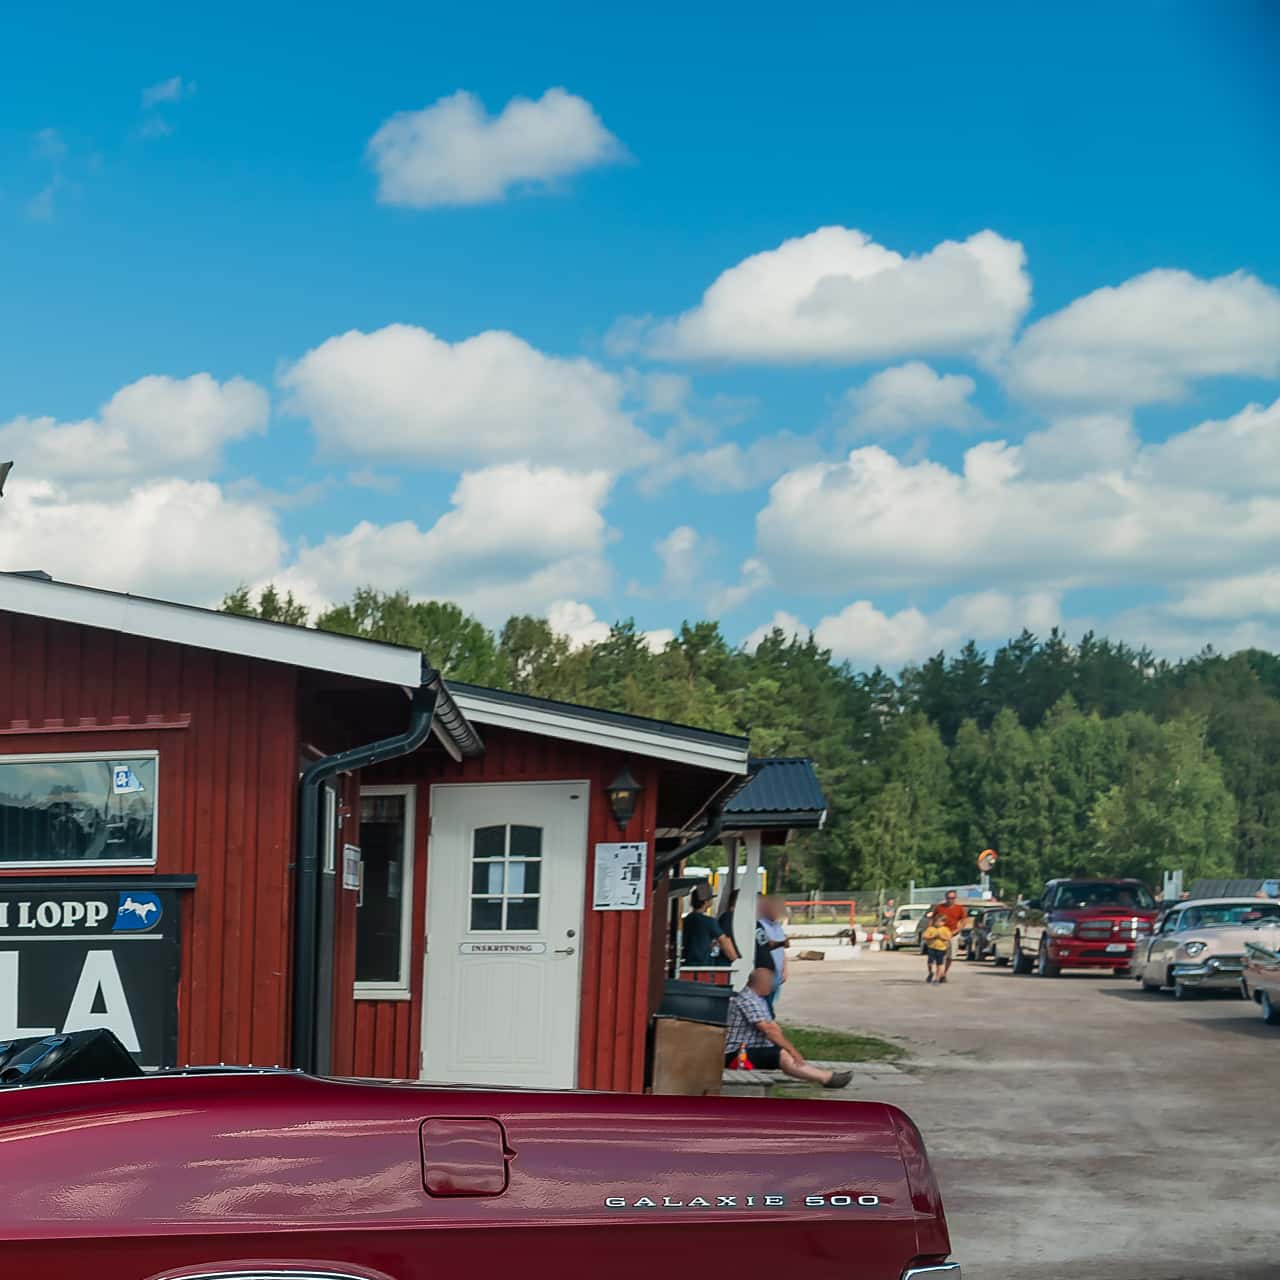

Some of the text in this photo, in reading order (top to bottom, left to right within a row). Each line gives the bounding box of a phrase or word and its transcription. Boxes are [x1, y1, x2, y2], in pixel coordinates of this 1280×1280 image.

[18, 901, 109, 928] LOPP
[605, 1194, 880, 1208] GALAXIE 500
